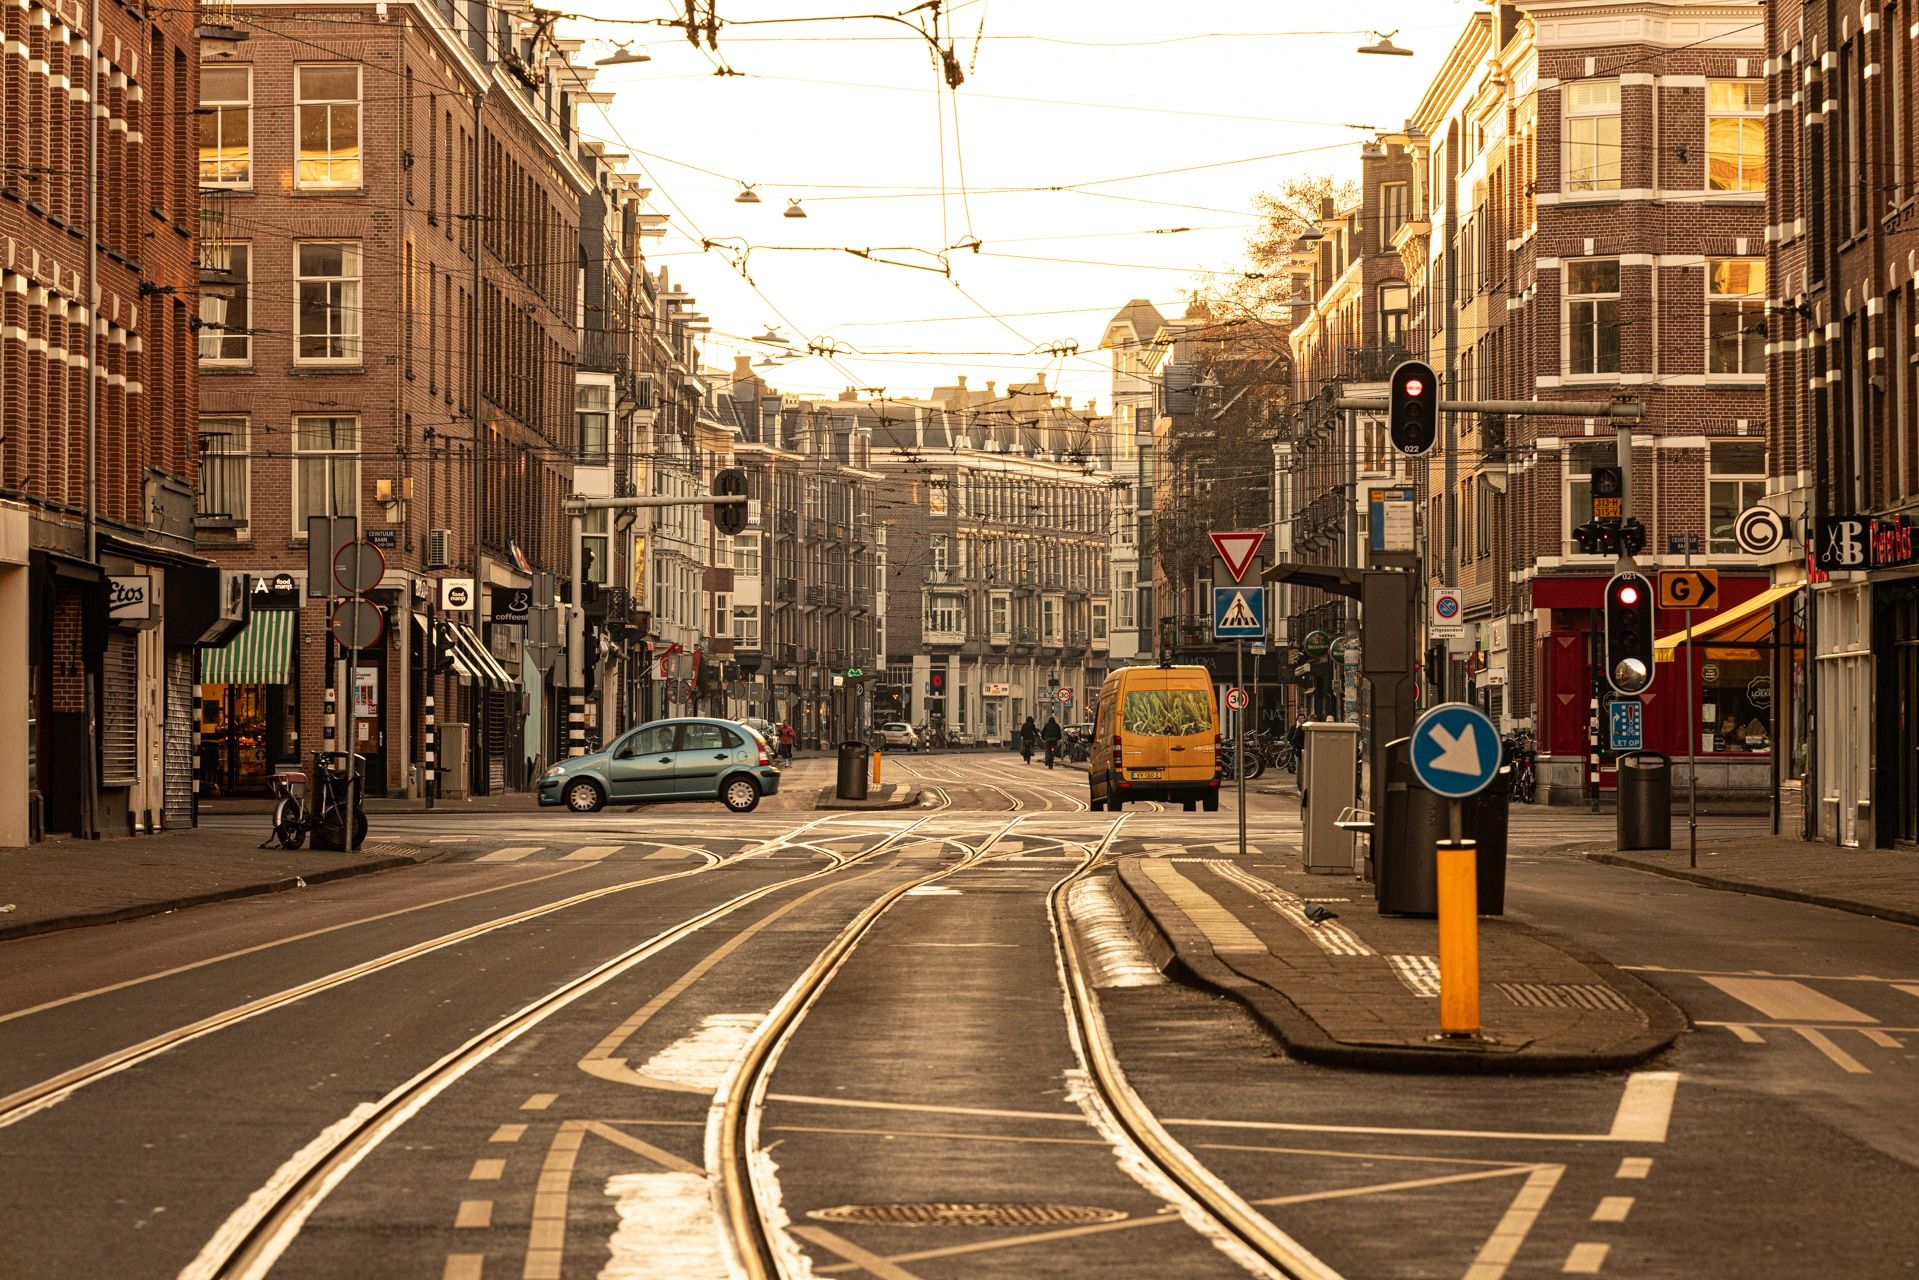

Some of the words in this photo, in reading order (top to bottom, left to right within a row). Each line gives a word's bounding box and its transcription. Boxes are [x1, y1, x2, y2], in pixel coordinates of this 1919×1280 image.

[1404, 445, 1419, 453] 022
[1595, 499, 1618, 507] 313-H
[1595, 508, 1620, 516] 315-V
[368, 530, 394, 538] CEINTUUR
[110, 581, 144, 603] Etos
[1670, 576, 1690, 601] G
[1059, 691, 1069, 699] 30
